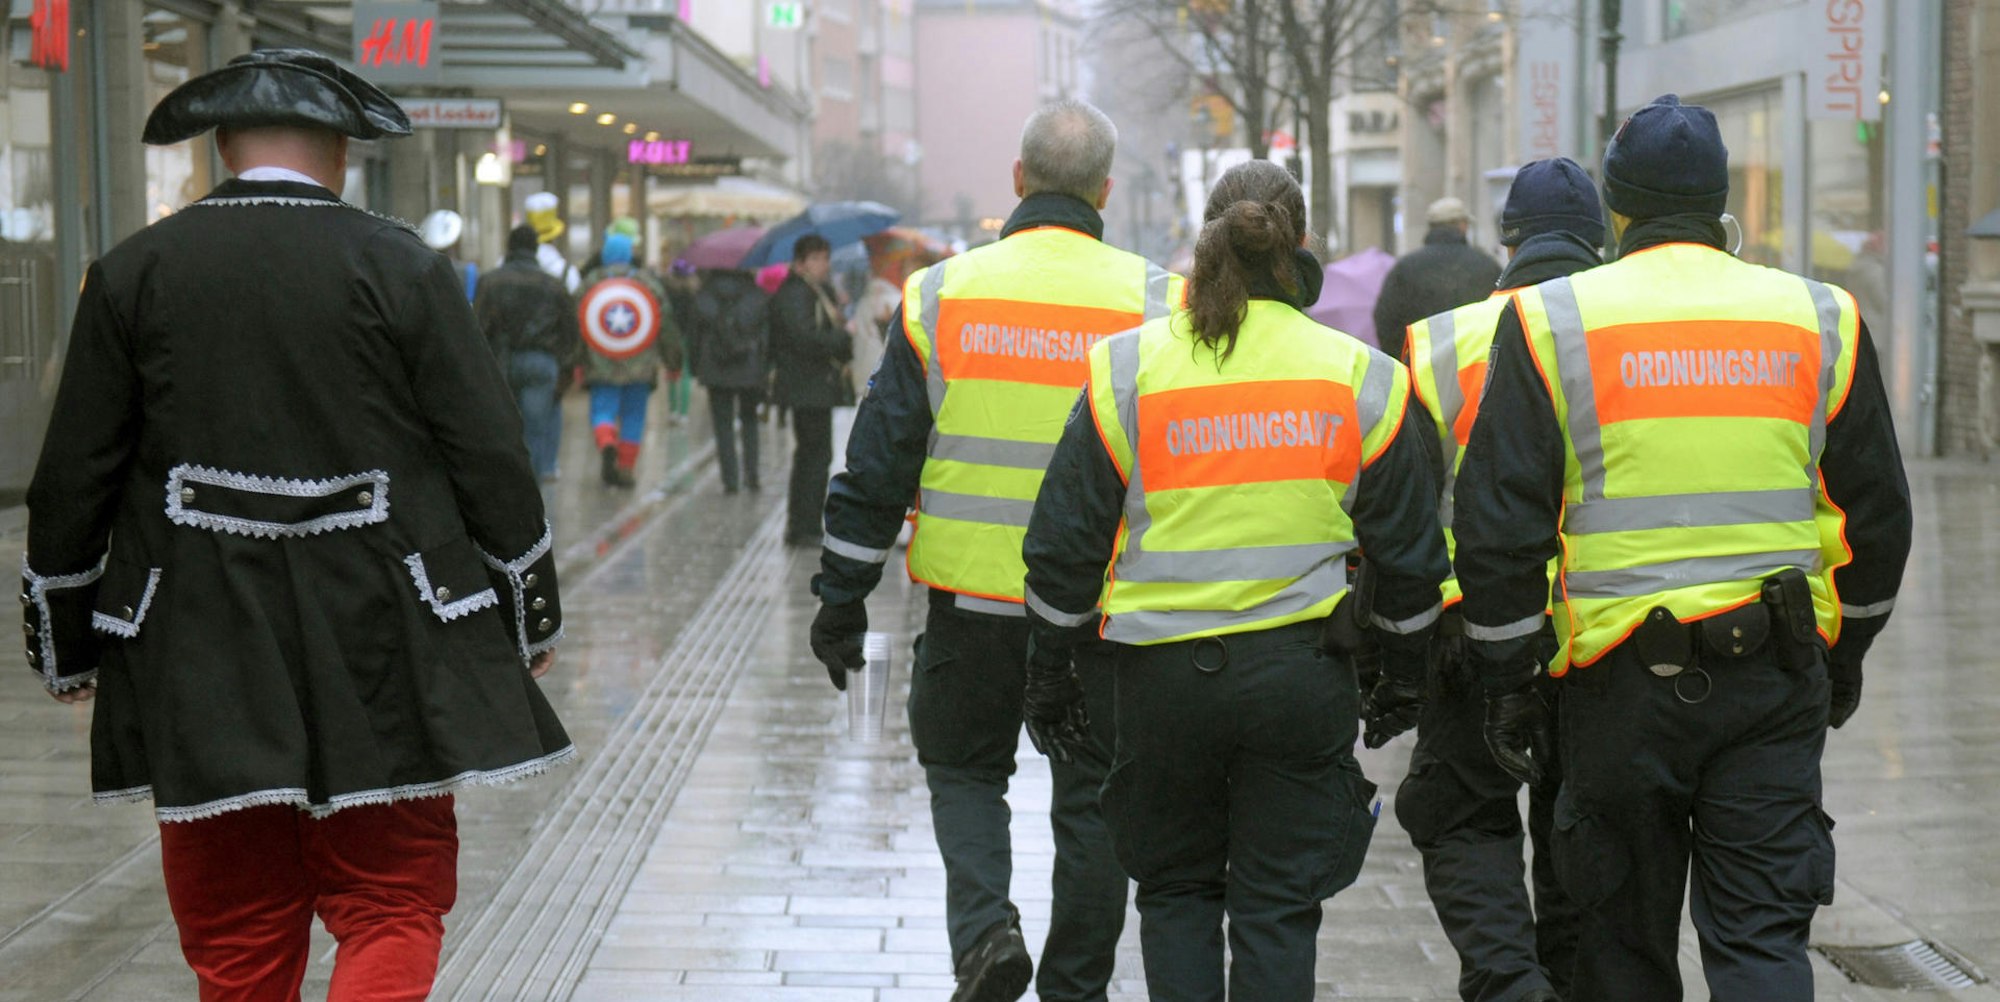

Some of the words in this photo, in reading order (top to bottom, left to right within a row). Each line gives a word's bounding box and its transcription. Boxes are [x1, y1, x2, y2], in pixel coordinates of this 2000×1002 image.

[361, 18, 434, 69] H&M
[960, 322, 1107, 362] ORDNUNGSA
[1620, 350, 1801, 389] ORDNUNGSAMT
[1167, 410, 1344, 456] ORDNUNGSAMT
